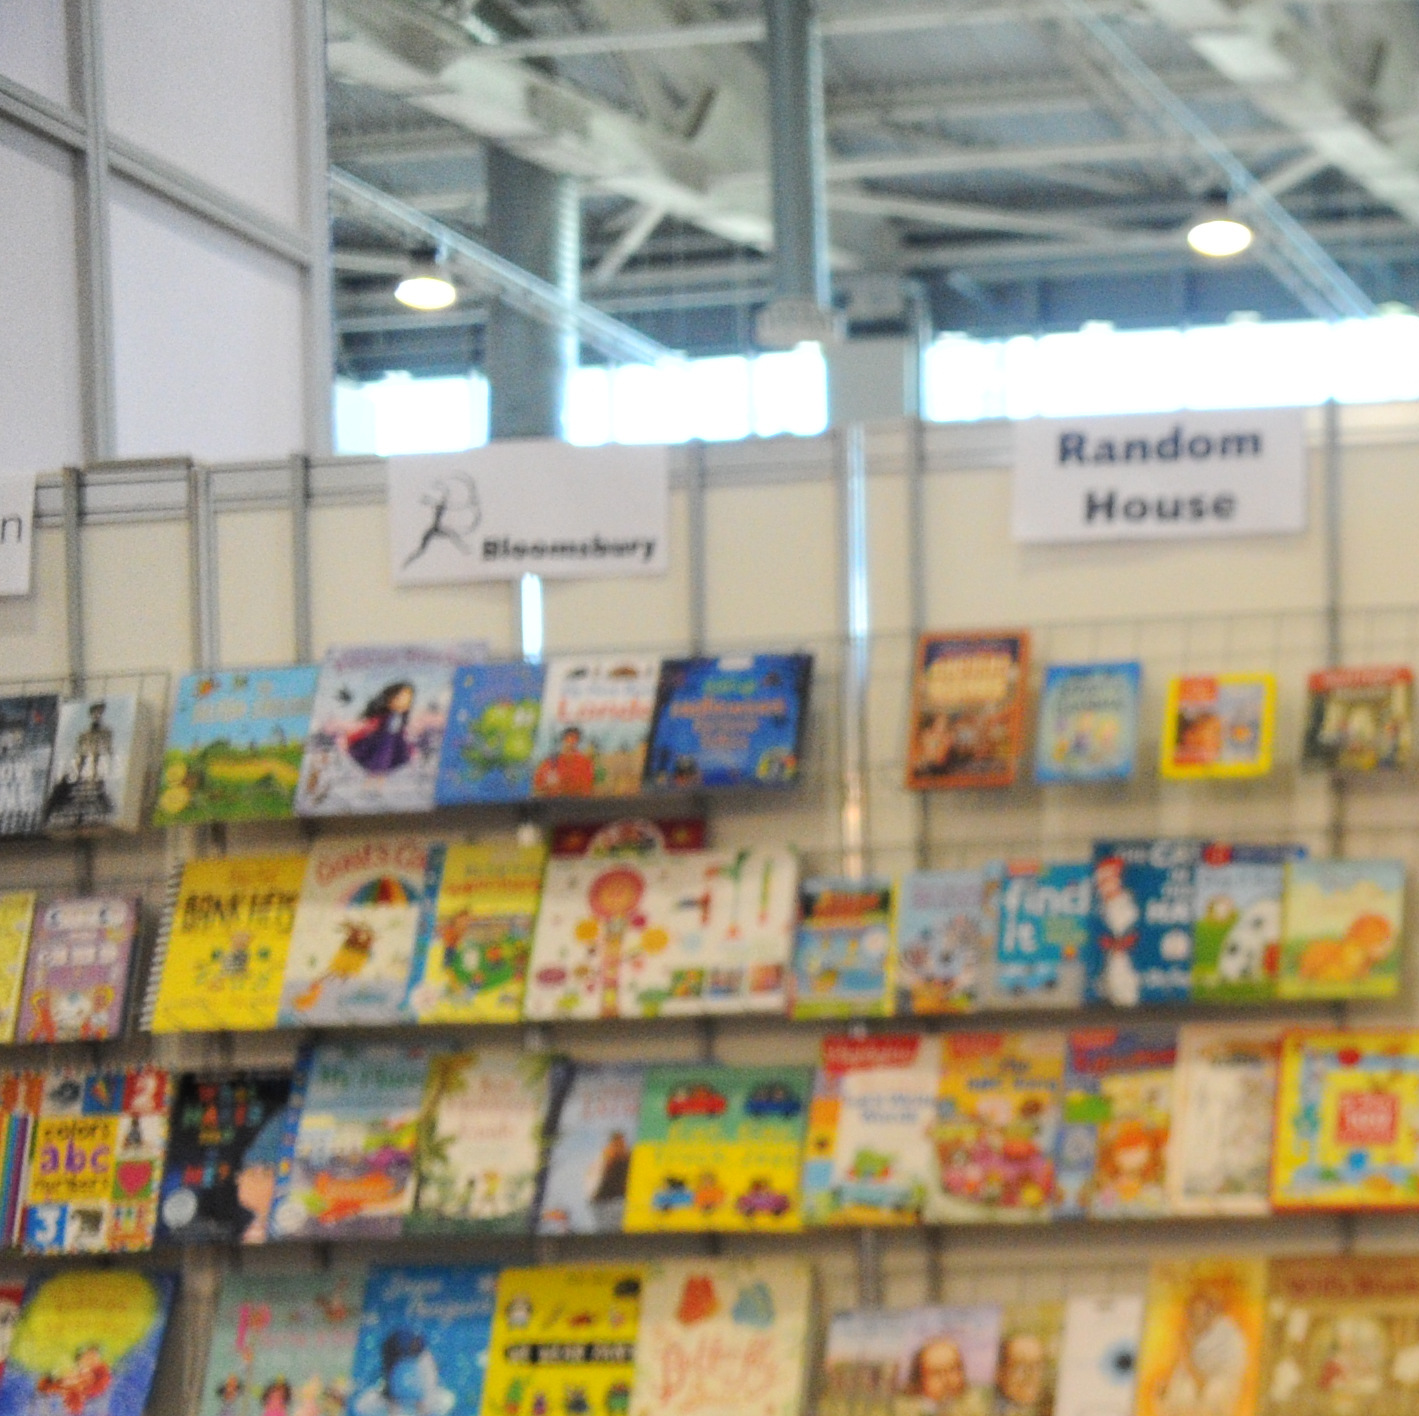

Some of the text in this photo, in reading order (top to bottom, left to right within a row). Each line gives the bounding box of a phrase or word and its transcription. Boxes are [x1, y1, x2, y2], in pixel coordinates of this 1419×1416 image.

[1058, 425, 1262, 466] Random
[1085, 488, 1239, 524] House
[481, 534, 656, 564] Bloomsbury
[1004, 881, 1090, 920] find
[1002, 916, 1033, 953] it
[39, 1138, 111, 1174] abc
